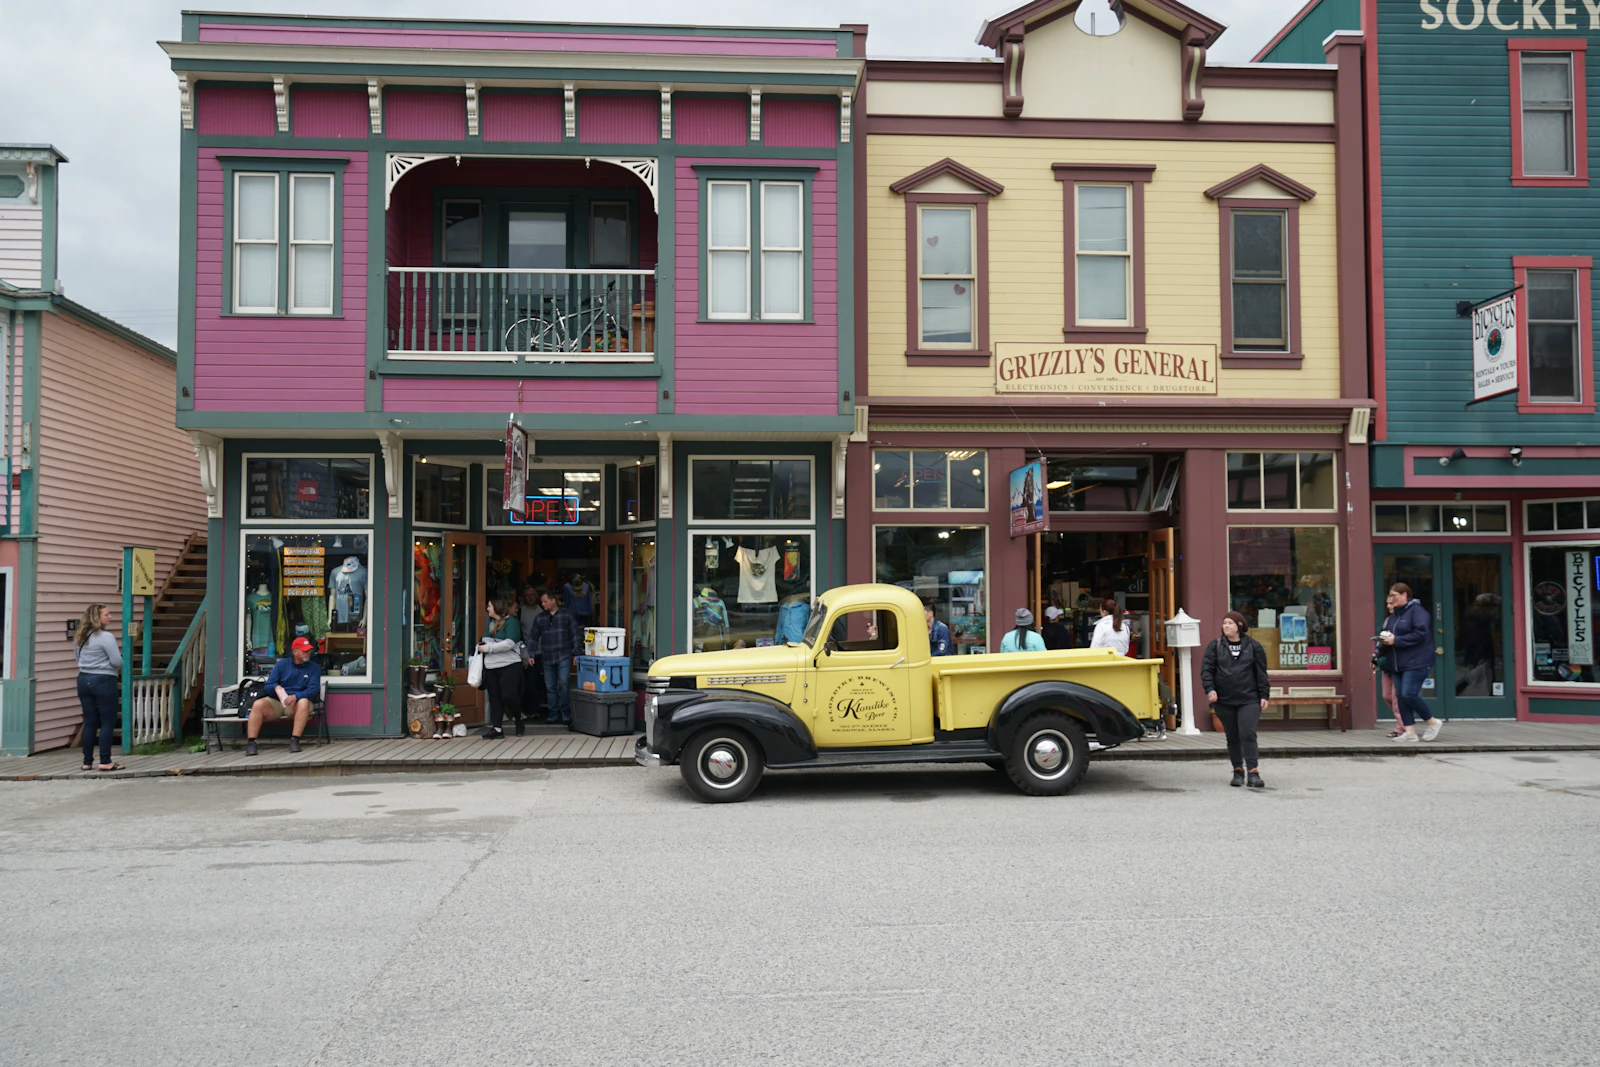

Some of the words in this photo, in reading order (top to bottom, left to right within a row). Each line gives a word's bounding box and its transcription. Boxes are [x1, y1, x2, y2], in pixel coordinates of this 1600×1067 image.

[1474, 298, 1515, 340] BICYCLES
[999, 347, 1105, 381] GRIZZLY'S
[1114, 348, 1214, 383] GENERAL
[1476, 366, 1496, 378] RENTALS
[1499, 360, 1516, 371] TOURS
[1477, 378, 1491, 388] SALES
[1495, 371, 1515, 383] SERVICE
[1128, 579, 1145, 592] elf
[1572, 552, 1586, 642] BICYCLES
[1279, 643, 1296, 653] FIX
[1298, 643, 1308, 653] IT
[1279, 654, 1308, 665] HERE
[1308, 654, 1329, 664] LEGO
[828, 677, 854, 723] KLONDIKE
[857, 675, 897, 704] BREWING
[836, 697, 890, 720] Klondike
[864, 711, 886, 721] Beer
